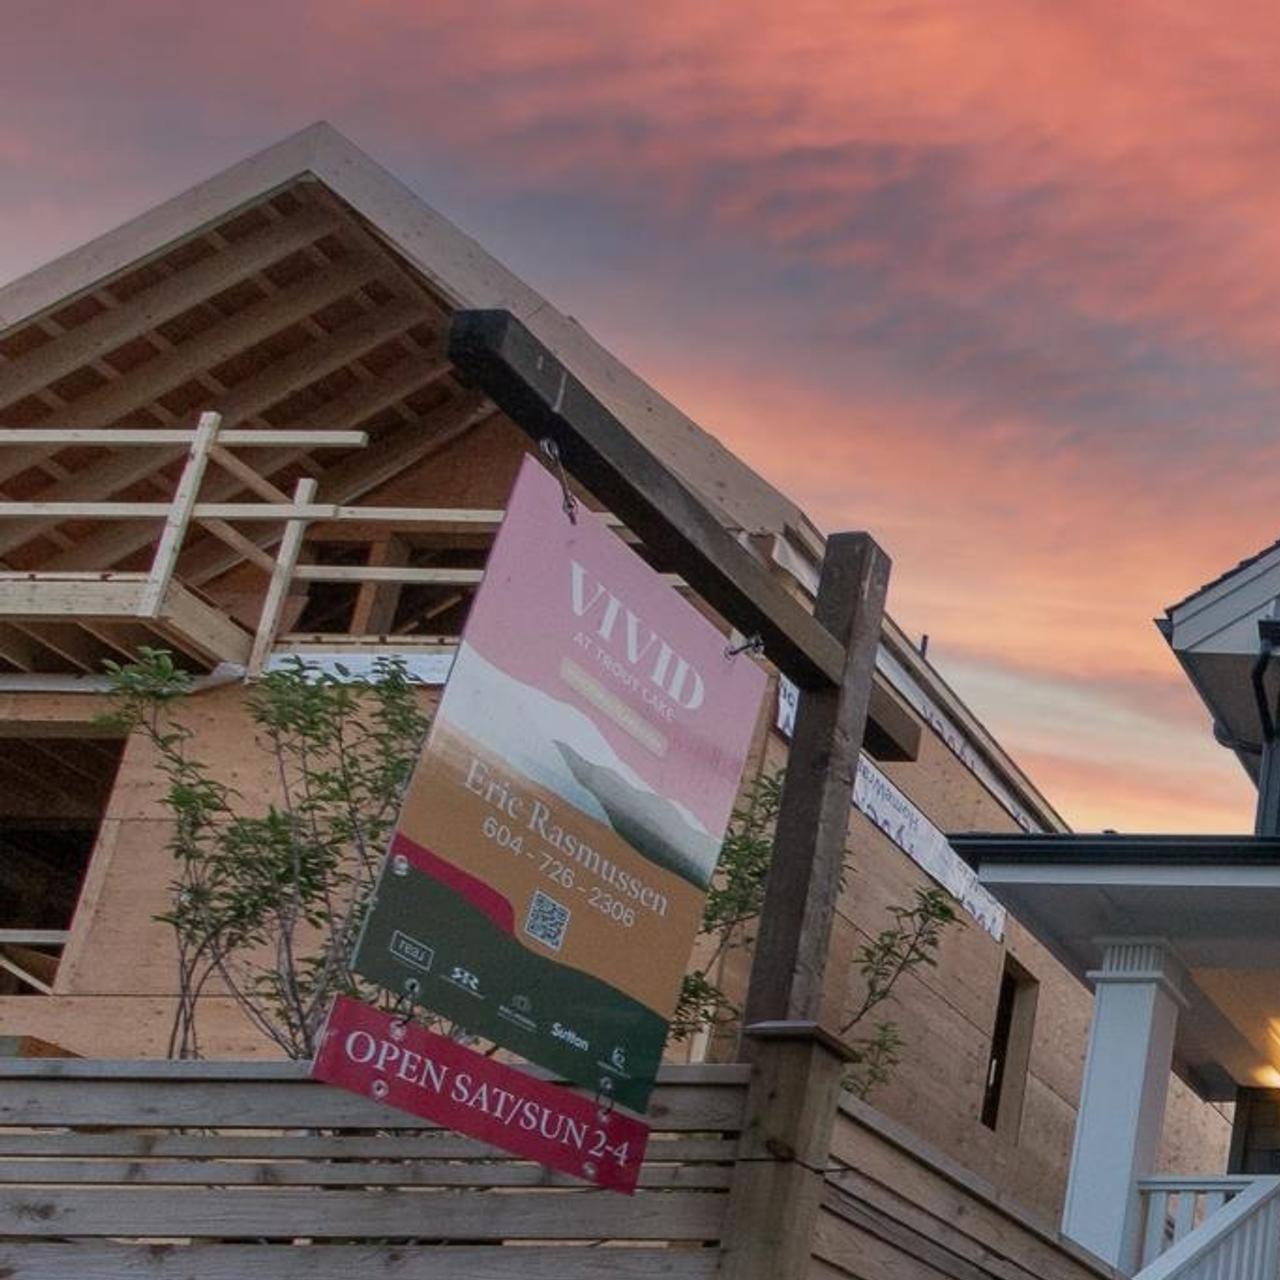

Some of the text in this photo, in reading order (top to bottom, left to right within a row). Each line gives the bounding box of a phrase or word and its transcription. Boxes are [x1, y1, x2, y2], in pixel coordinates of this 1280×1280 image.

[570, 559, 705, 710] VIVID
[573, 631, 677, 720] AT TROUT LAKE
[464, 756, 669, 916] Eric Rasmussen
[345, 1031, 630, 1167] OPEN SAT/SUN 2-4
[552, 1022, 589, 1051] Sutton
